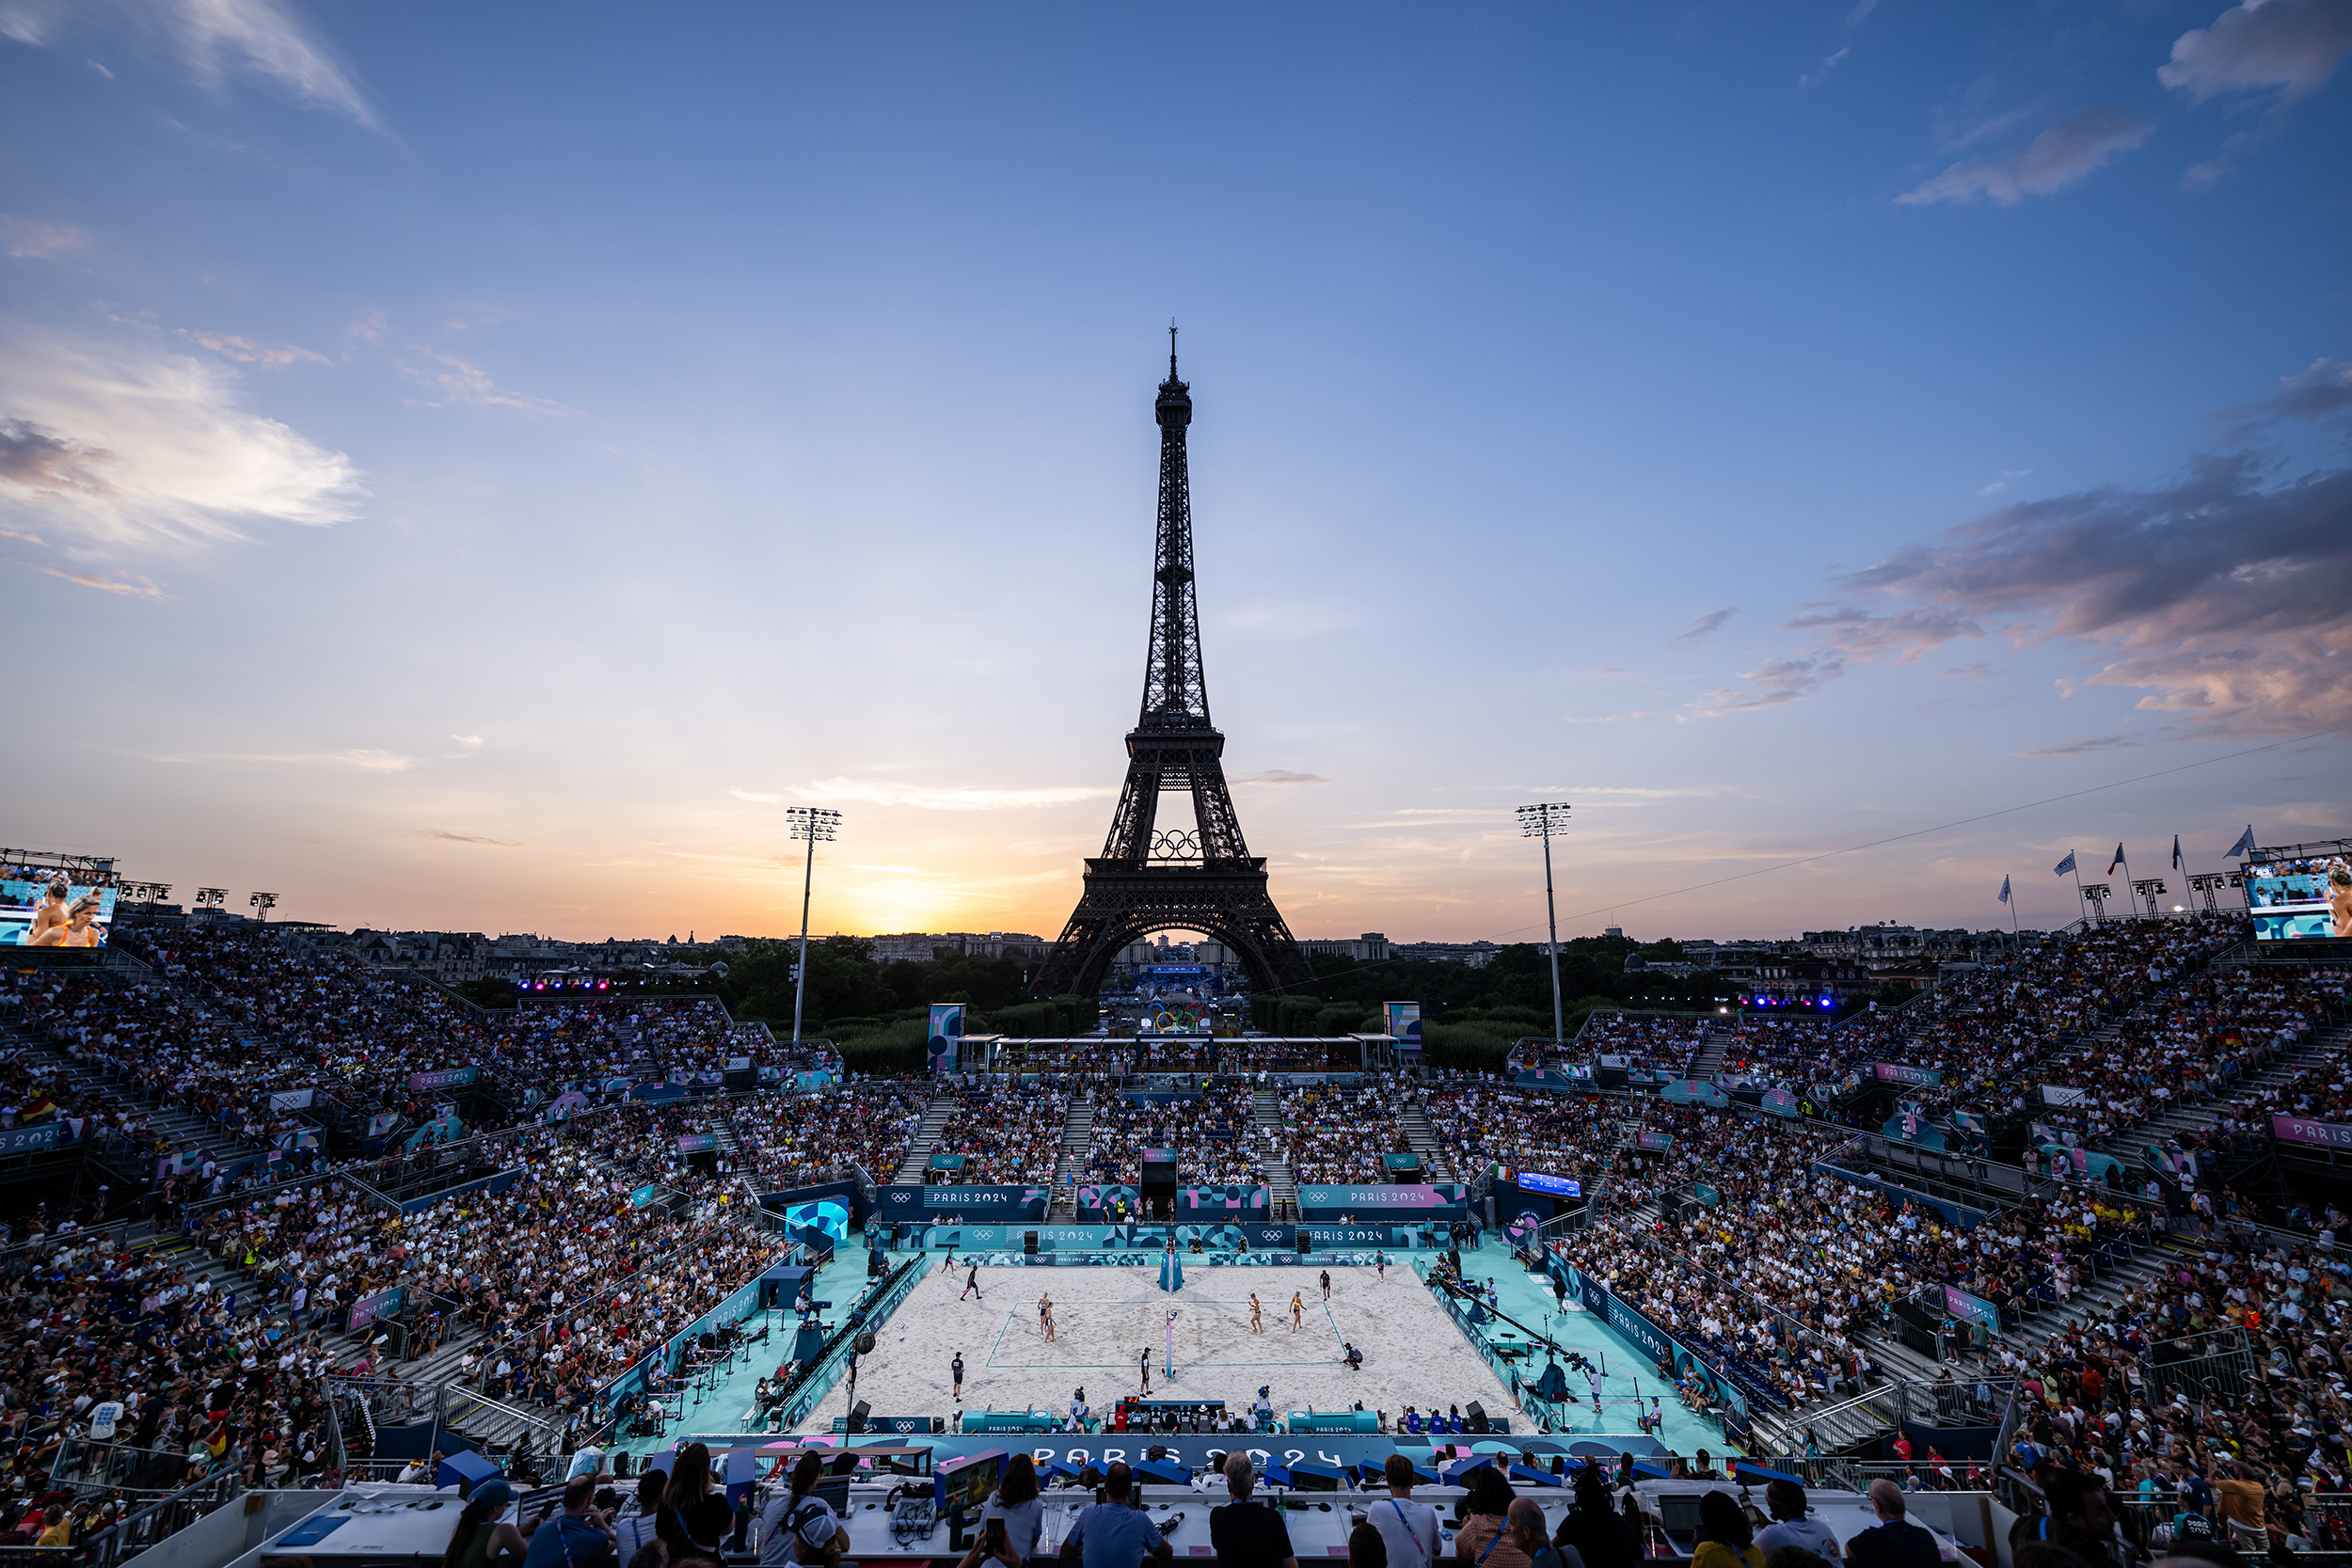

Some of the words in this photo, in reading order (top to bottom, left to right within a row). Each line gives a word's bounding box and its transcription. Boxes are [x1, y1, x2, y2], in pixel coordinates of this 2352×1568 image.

[2294, 1124, 2351, 1143] PARIS
[933, 1193, 970, 1202] PARIS
[975, 1193, 1008, 1202] 2024
[1351, 1192, 1388, 1202] PARIS
[1391, 1192, 1424, 1202] 2024
[1059, 1230, 1093, 1241] 2024
[1348, 1230, 1383, 1241] 2024
[1613, 1308, 1640, 1338] PARIS
